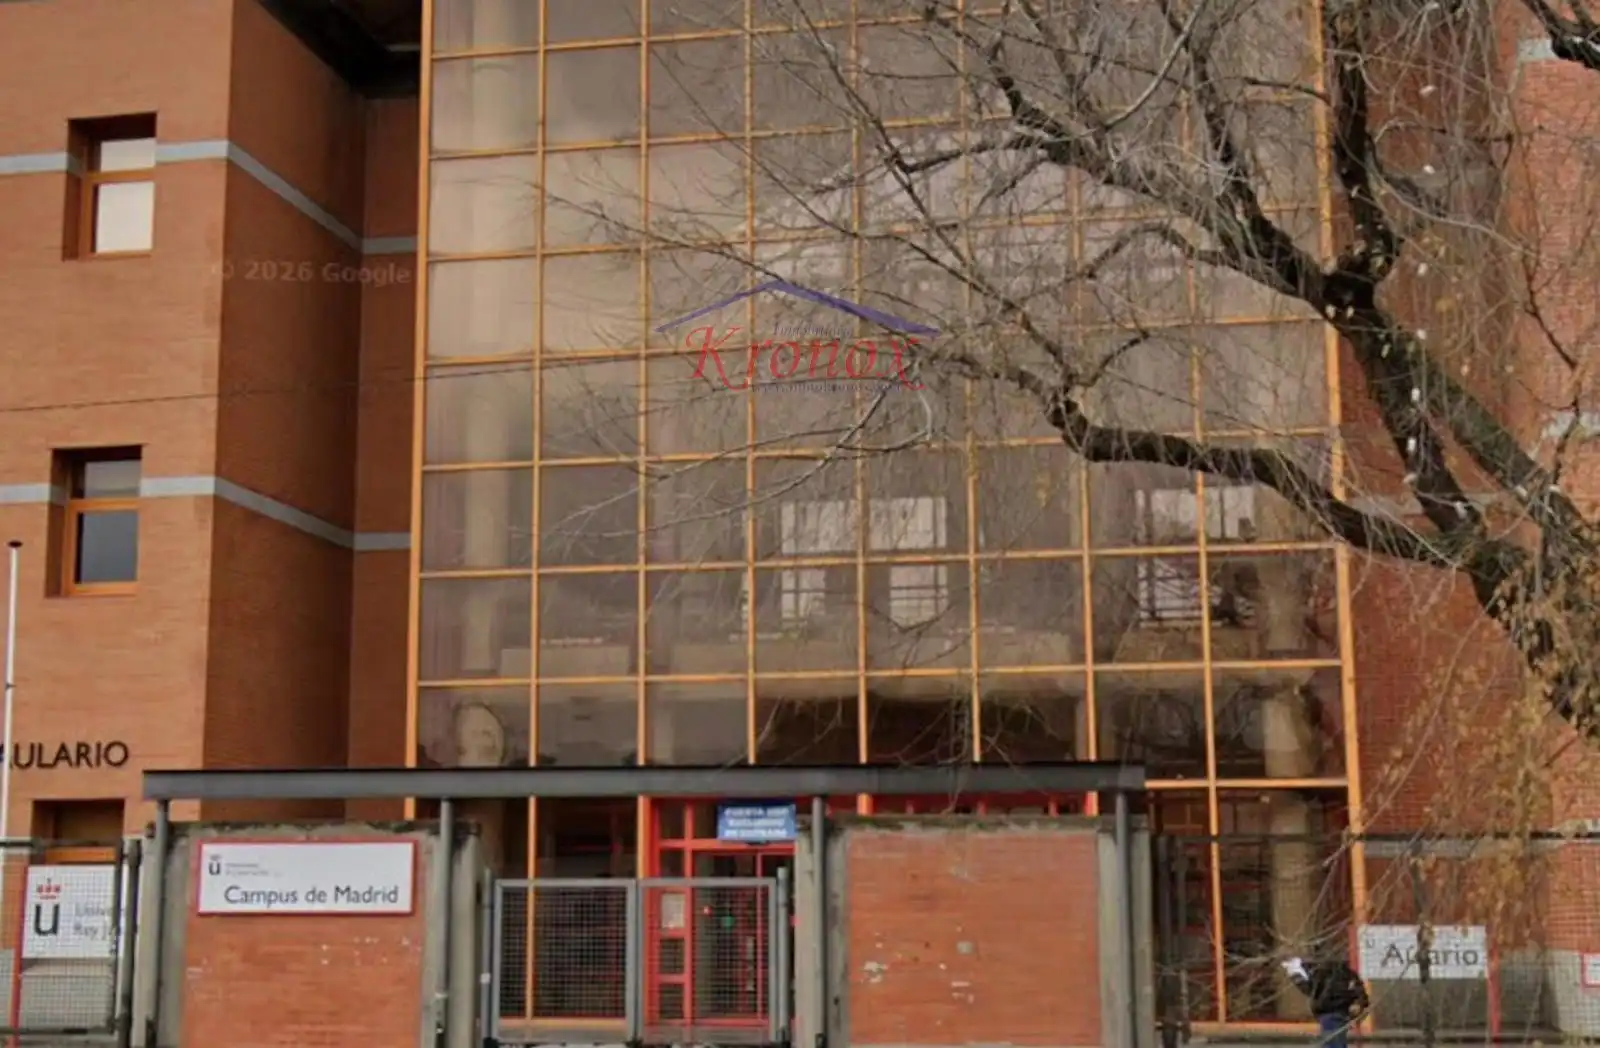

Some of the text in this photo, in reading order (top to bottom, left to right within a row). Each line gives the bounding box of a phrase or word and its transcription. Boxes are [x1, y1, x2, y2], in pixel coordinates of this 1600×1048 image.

[224, 885, 399, 908] Campus de Madrid
